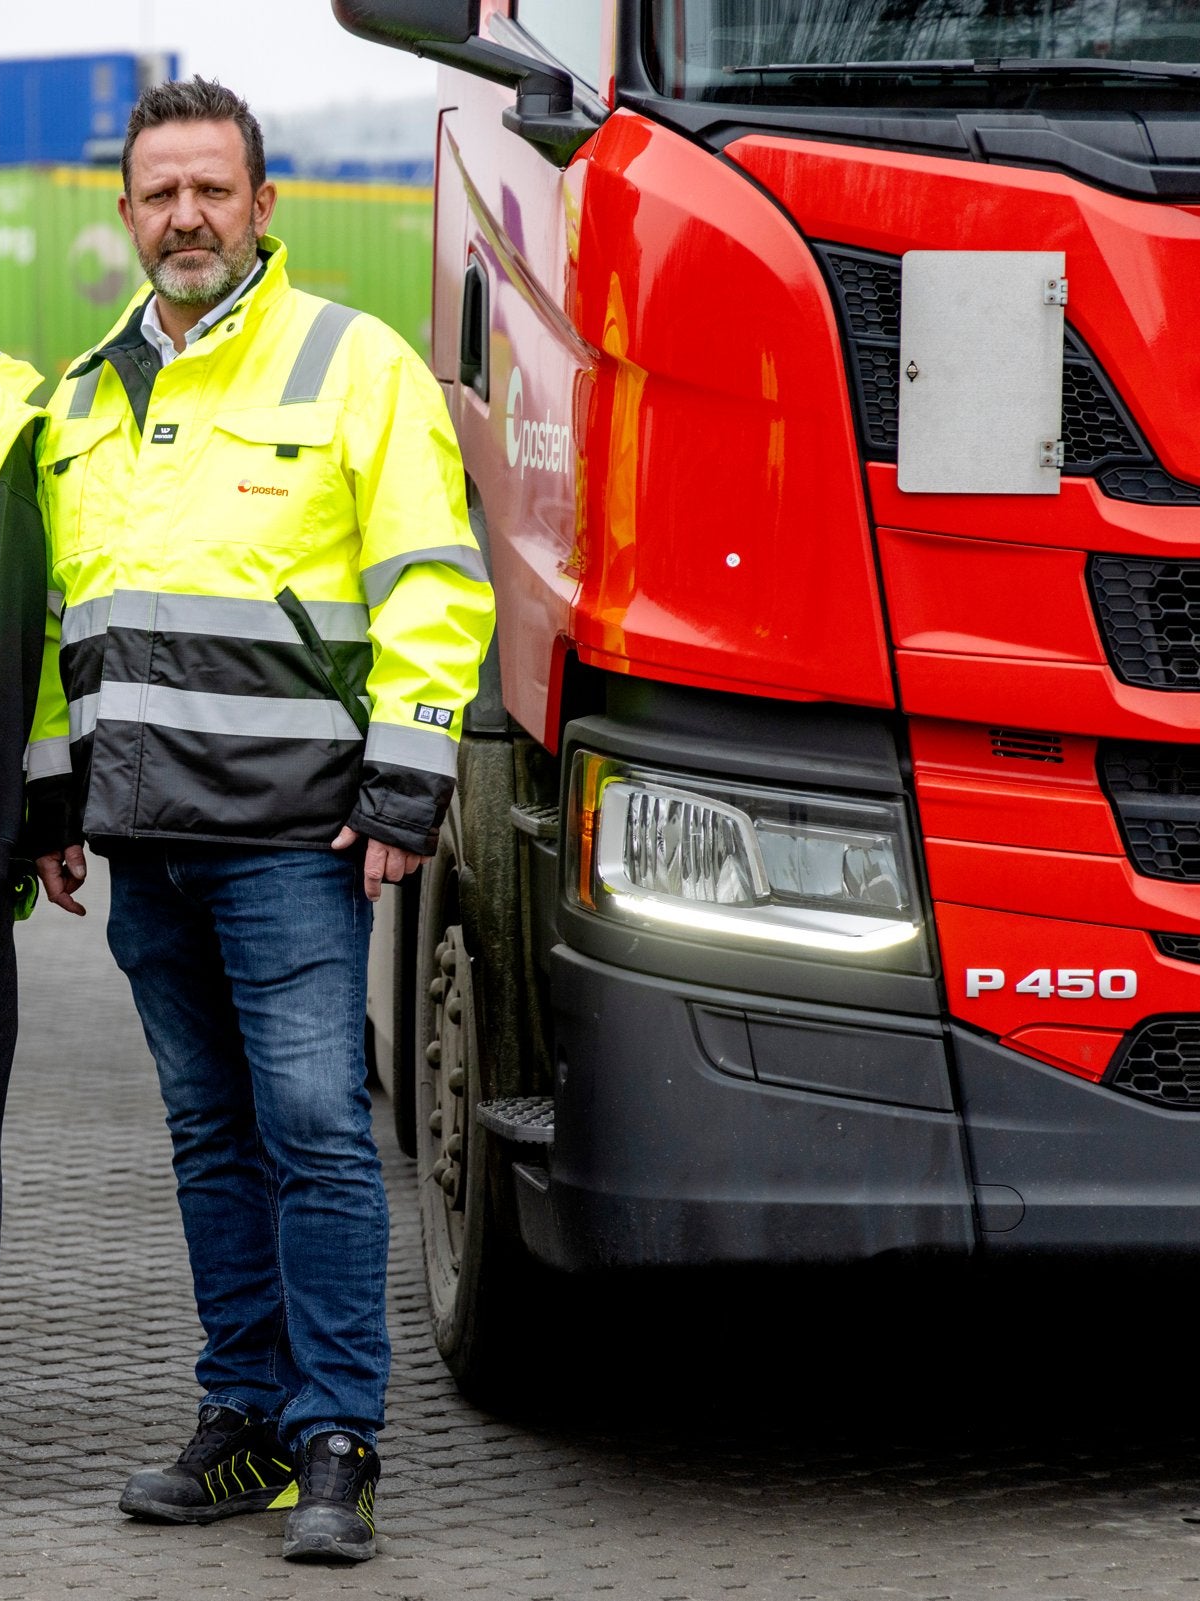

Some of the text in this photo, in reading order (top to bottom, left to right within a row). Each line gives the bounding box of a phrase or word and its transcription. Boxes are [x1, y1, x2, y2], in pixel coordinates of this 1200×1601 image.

[521, 408, 570, 480] posten
[251, 486, 289, 497] posten
[966, 968, 1138, 999] P 450
